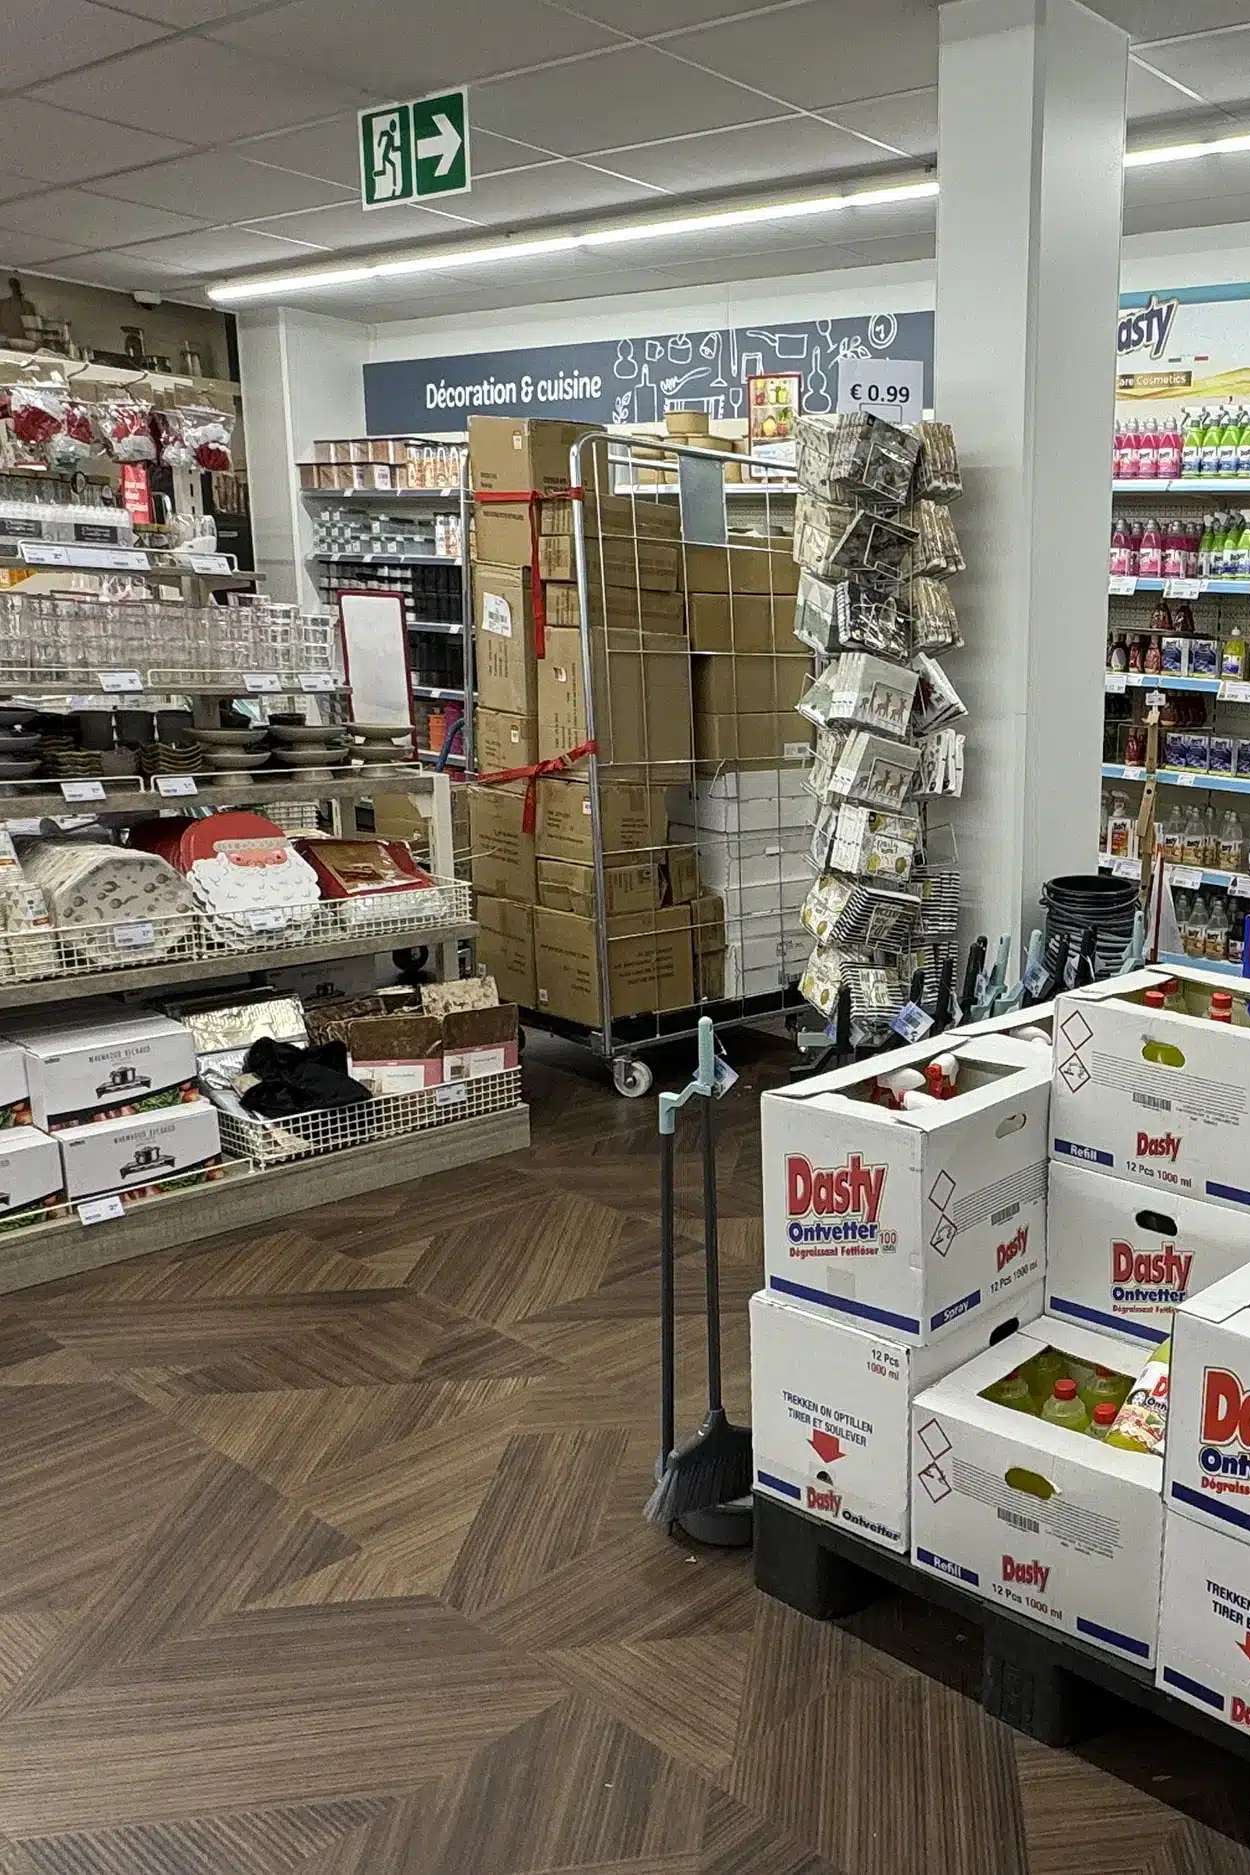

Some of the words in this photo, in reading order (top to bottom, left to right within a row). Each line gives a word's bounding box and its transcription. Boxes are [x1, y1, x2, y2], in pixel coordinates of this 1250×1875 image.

[1118, 297, 1177, 357] asty
[426, 376, 516, 409] Décoration
[521, 376, 534, 403] &
[537, 369, 602, 402] cuisine
[850, 383, 863, 401] €
[868, 384, 910, 403] 0.99
[1117, 375, 1135, 388] are
[1136, 373, 1187, 386] Cosmetics
[1070, 1144, 1098, 1162] Refill
[1135, 1131, 1182, 1163] Dasty
[786, 1153, 888, 1223] Dasty
[1126, 1160, 1136, 1172] 12
[1138, 1163, 1155, 1178] Pcs
[1157, 1167, 1178, 1186] 1000
[1180, 1176, 1192, 1189] ml
[787, 1221, 878, 1244] Ontvetter
[879, 1231, 898, 1245] 100
[789, 1246, 838, 1258] Dégraissant
[996, 1225, 1029, 1272] Dasty
[1111, 1239, 1195, 1291] Dasty
[990, 1281, 999, 1294] 12
[1000, 1274, 1012, 1289] Pcs
[1112, 1286, 1186, 1302] Ontvetter
[943, 1300, 969, 1322] Spray
[866, 1361, 887, 1378] 1000
[888, 1369, 900, 1381] ml
[871, 1349, 882, 1362] 12
[884, 1354, 900, 1368] Pcs
[782, 1390, 819, 1412] TREKKEN
[820, 1402, 833, 1418] ON
[834, 1407, 874, 1434] OPTILLEN
[788, 1408, 811, 1426] TIRER
[812, 1415, 823, 1429] ET
[824, 1419, 867, 1447] SOULEVER
[806, 1486, 843, 1517] Dasty
[842, 1509, 901, 1542] Ontvetter
[933, 1556, 962, 1578] Refill
[1001, 1554, 1050, 1592] Dasty
[992, 1583, 1002, 1595] 12
[1005, 1587, 1022, 1603] Pcs
[1024, 1594, 1048, 1616] 1000
[1050, 1604, 1063, 1620] ml
[1212, 1600, 1244, 1628] TIRER
